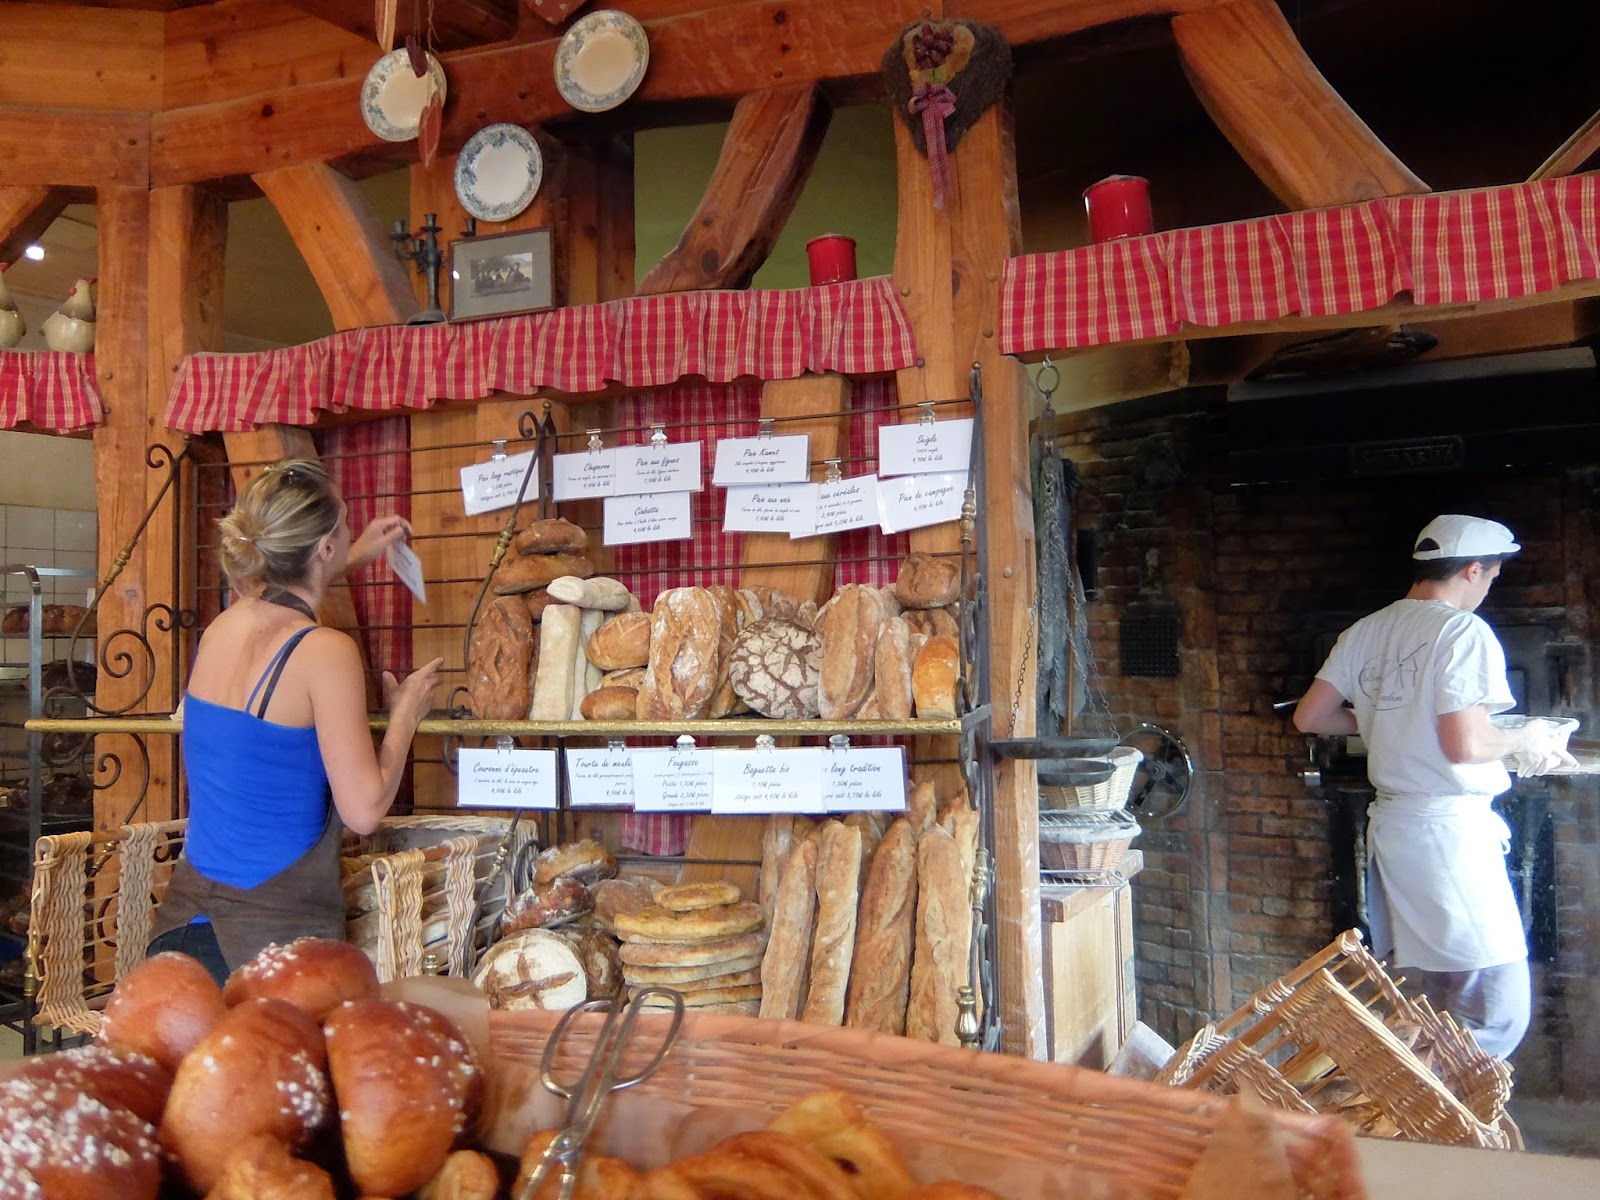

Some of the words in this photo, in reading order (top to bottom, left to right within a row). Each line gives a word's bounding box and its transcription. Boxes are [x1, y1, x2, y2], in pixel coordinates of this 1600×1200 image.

[916, 434, 937, 446] Seigle
[744, 448, 756, 457] Pain
[759, 448, 780, 456] Kamut
[636, 458, 648, 466] Pain
[662, 456, 680, 467] figues
[478, 474, 488, 483] Pain
[491, 472, 502, 482] long
[832, 485, 860, 497] céréales
[898, 492, 912, 502] Pain
[915, 490, 922, 498] de
[924, 486, 954, 496] campagne
[752, 494, 764, 502] Pain
[634, 507, 658, 516] Ciabatta
[575, 758, 598, 768] Tourte
[602, 758, 609, 767] de
[668, 757, 698, 770] Fougasse
[473, 762, 502, 772] Couronne
[504, 763, 539, 776] d'épeautre
[744, 763, 776, 777] Baguette
[779, 764, 790, 773] bio
[831, 762, 846, 776] long
[850, 762, 880, 772] tradition
[788, 791, 798, 799] kilo
